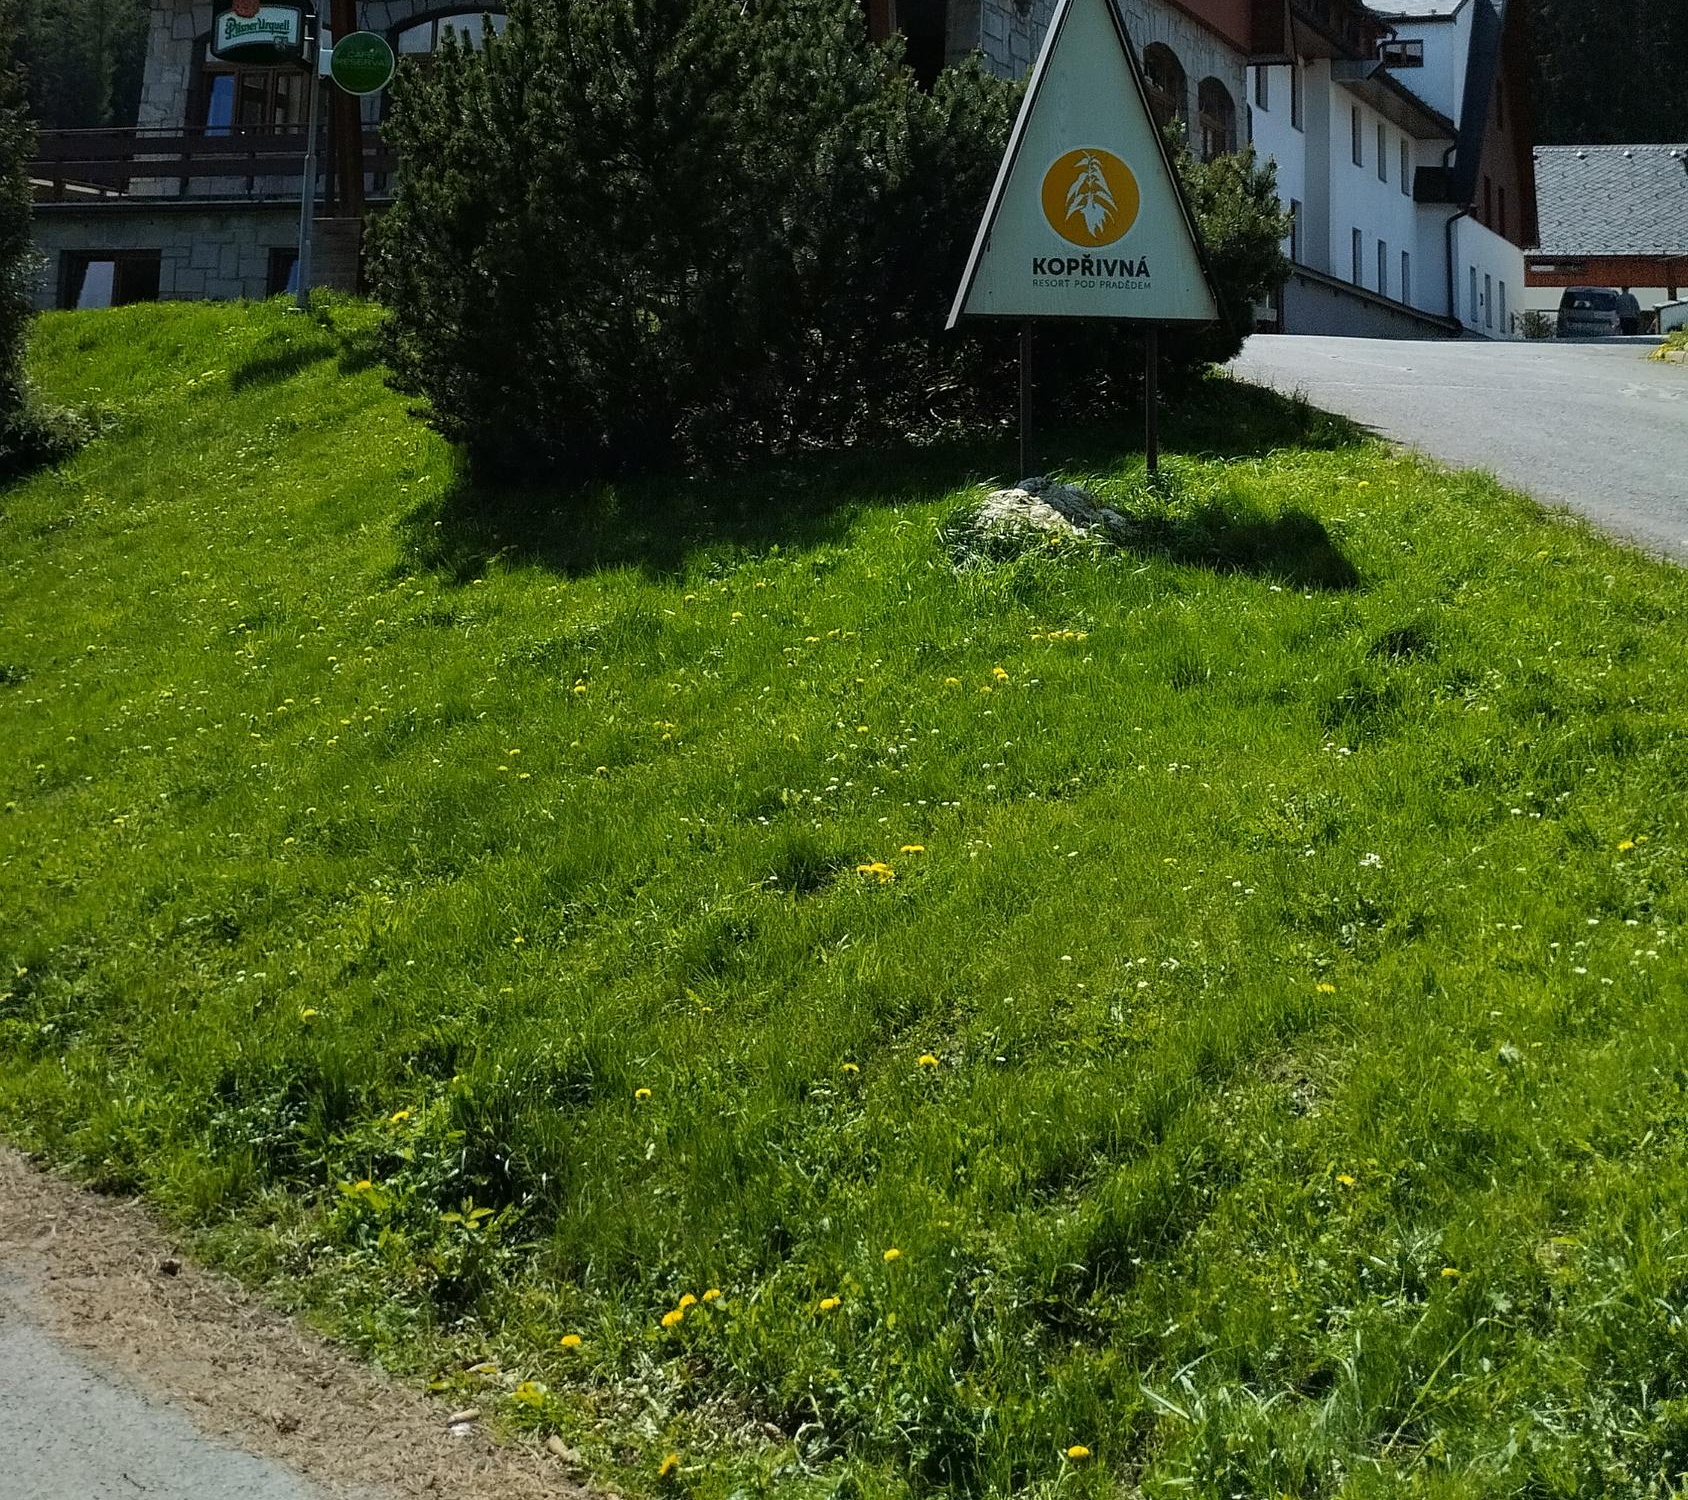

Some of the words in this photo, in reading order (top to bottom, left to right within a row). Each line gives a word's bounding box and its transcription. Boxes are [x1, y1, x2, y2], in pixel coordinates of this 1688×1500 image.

[225, 17, 257, 40] Pilsner
[257, 17, 290, 34] Urquell
[1032, 253, 1150, 278] KOPŘIVNÁ
[1032, 279, 1070, 288] RESORT
[1074, 279, 1096, 288] POD
[1099, 280, 1151, 290] PRADĚDEM
